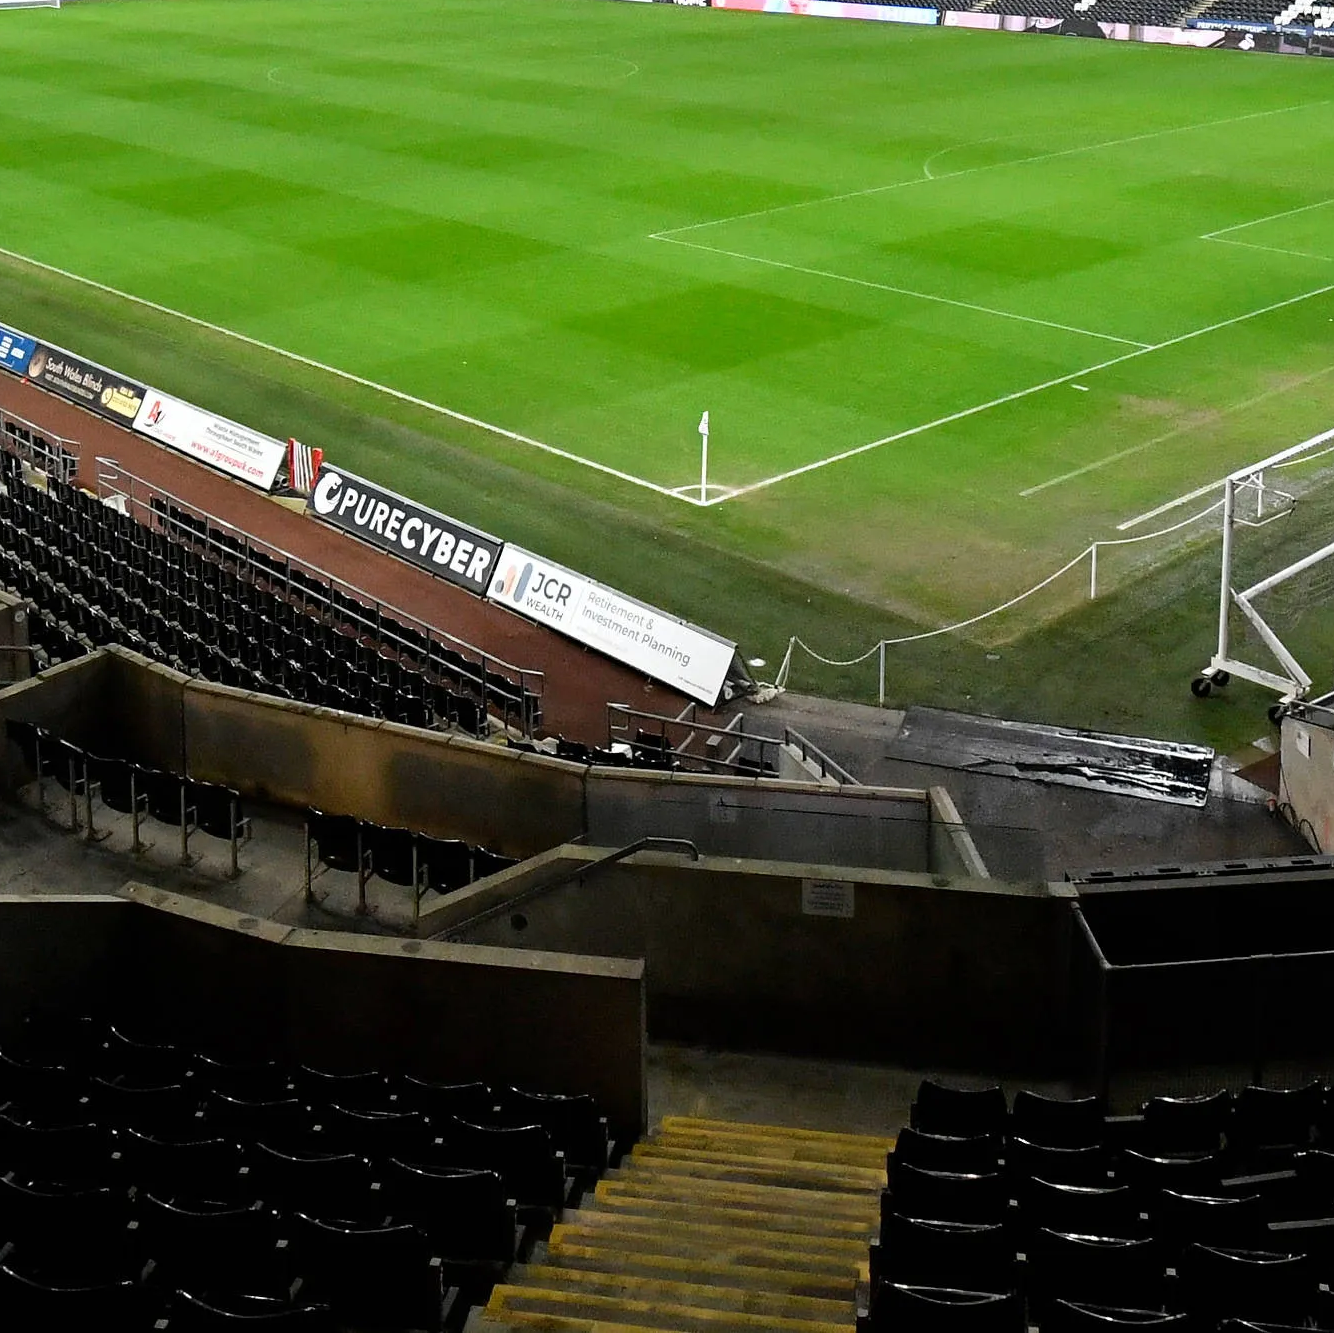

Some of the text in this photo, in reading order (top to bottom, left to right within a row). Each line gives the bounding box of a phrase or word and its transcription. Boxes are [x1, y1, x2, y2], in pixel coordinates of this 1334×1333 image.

[45, 357, 65, 376] South
[63, 364, 83, 384] Wales
[82, 373, 103, 393] Blinds
[338, 487, 492, 583] PURECYBER
[526, 595, 564, 622] WEALTH
[531, 572, 572, 607] JCR
[588, 591, 655, 631] Retirement &
[582, 606, 692, 668] Investment Planning
